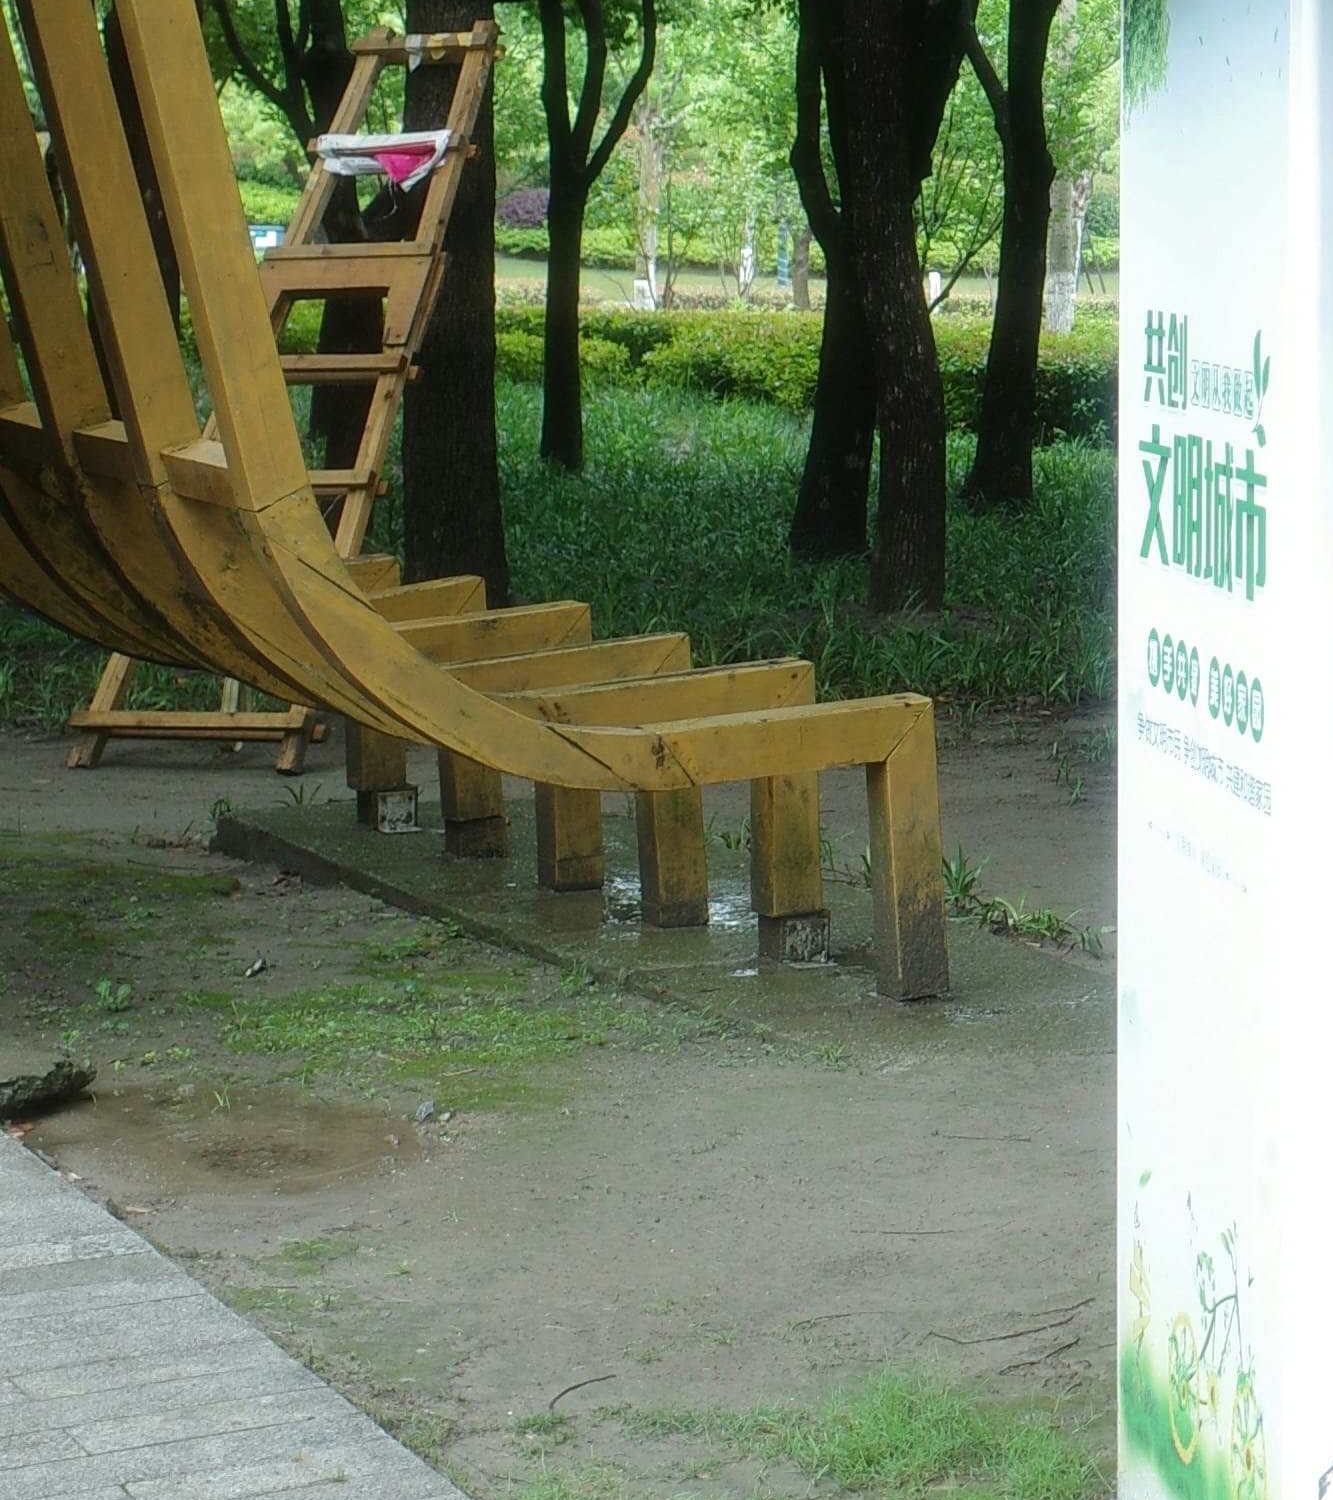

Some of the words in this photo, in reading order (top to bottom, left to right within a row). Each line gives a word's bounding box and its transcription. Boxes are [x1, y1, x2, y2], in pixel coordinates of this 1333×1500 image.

[1143, 310, 1189, 411] 共创
[1138, 423, 1268, 602] 文明城市
